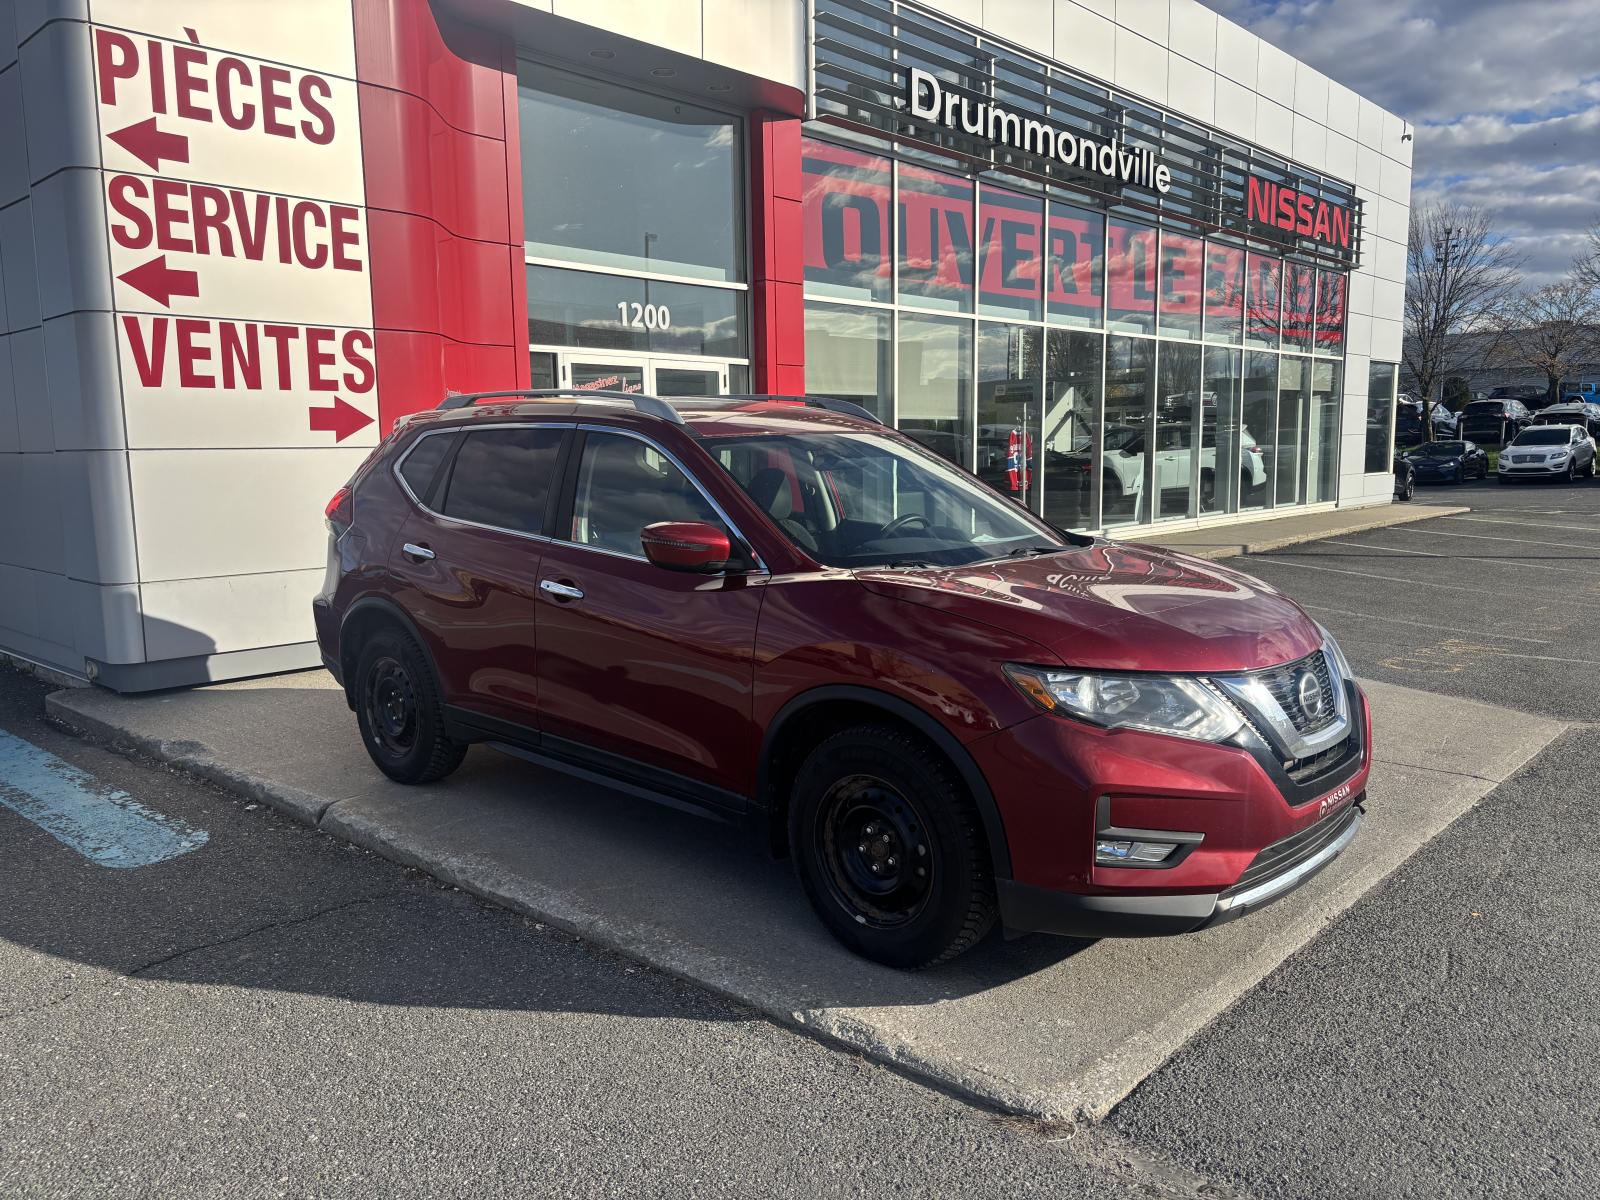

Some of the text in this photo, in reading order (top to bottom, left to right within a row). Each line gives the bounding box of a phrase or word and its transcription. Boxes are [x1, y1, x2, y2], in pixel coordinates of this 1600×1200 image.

[95, 27, 336, 145] PIÈCES
[910, 67, 1172, 193] Drummondville
[108, 175, 363, 272] SERVICE
[822, 191, 1114, 297] OUVERT
[1247, 175, 1351, 249] NISSAN
[121, 315, 376, 394] VENTES
[617, 301, 671, 330] 1200
[1327, 784, 1350, 806] NISSAN
